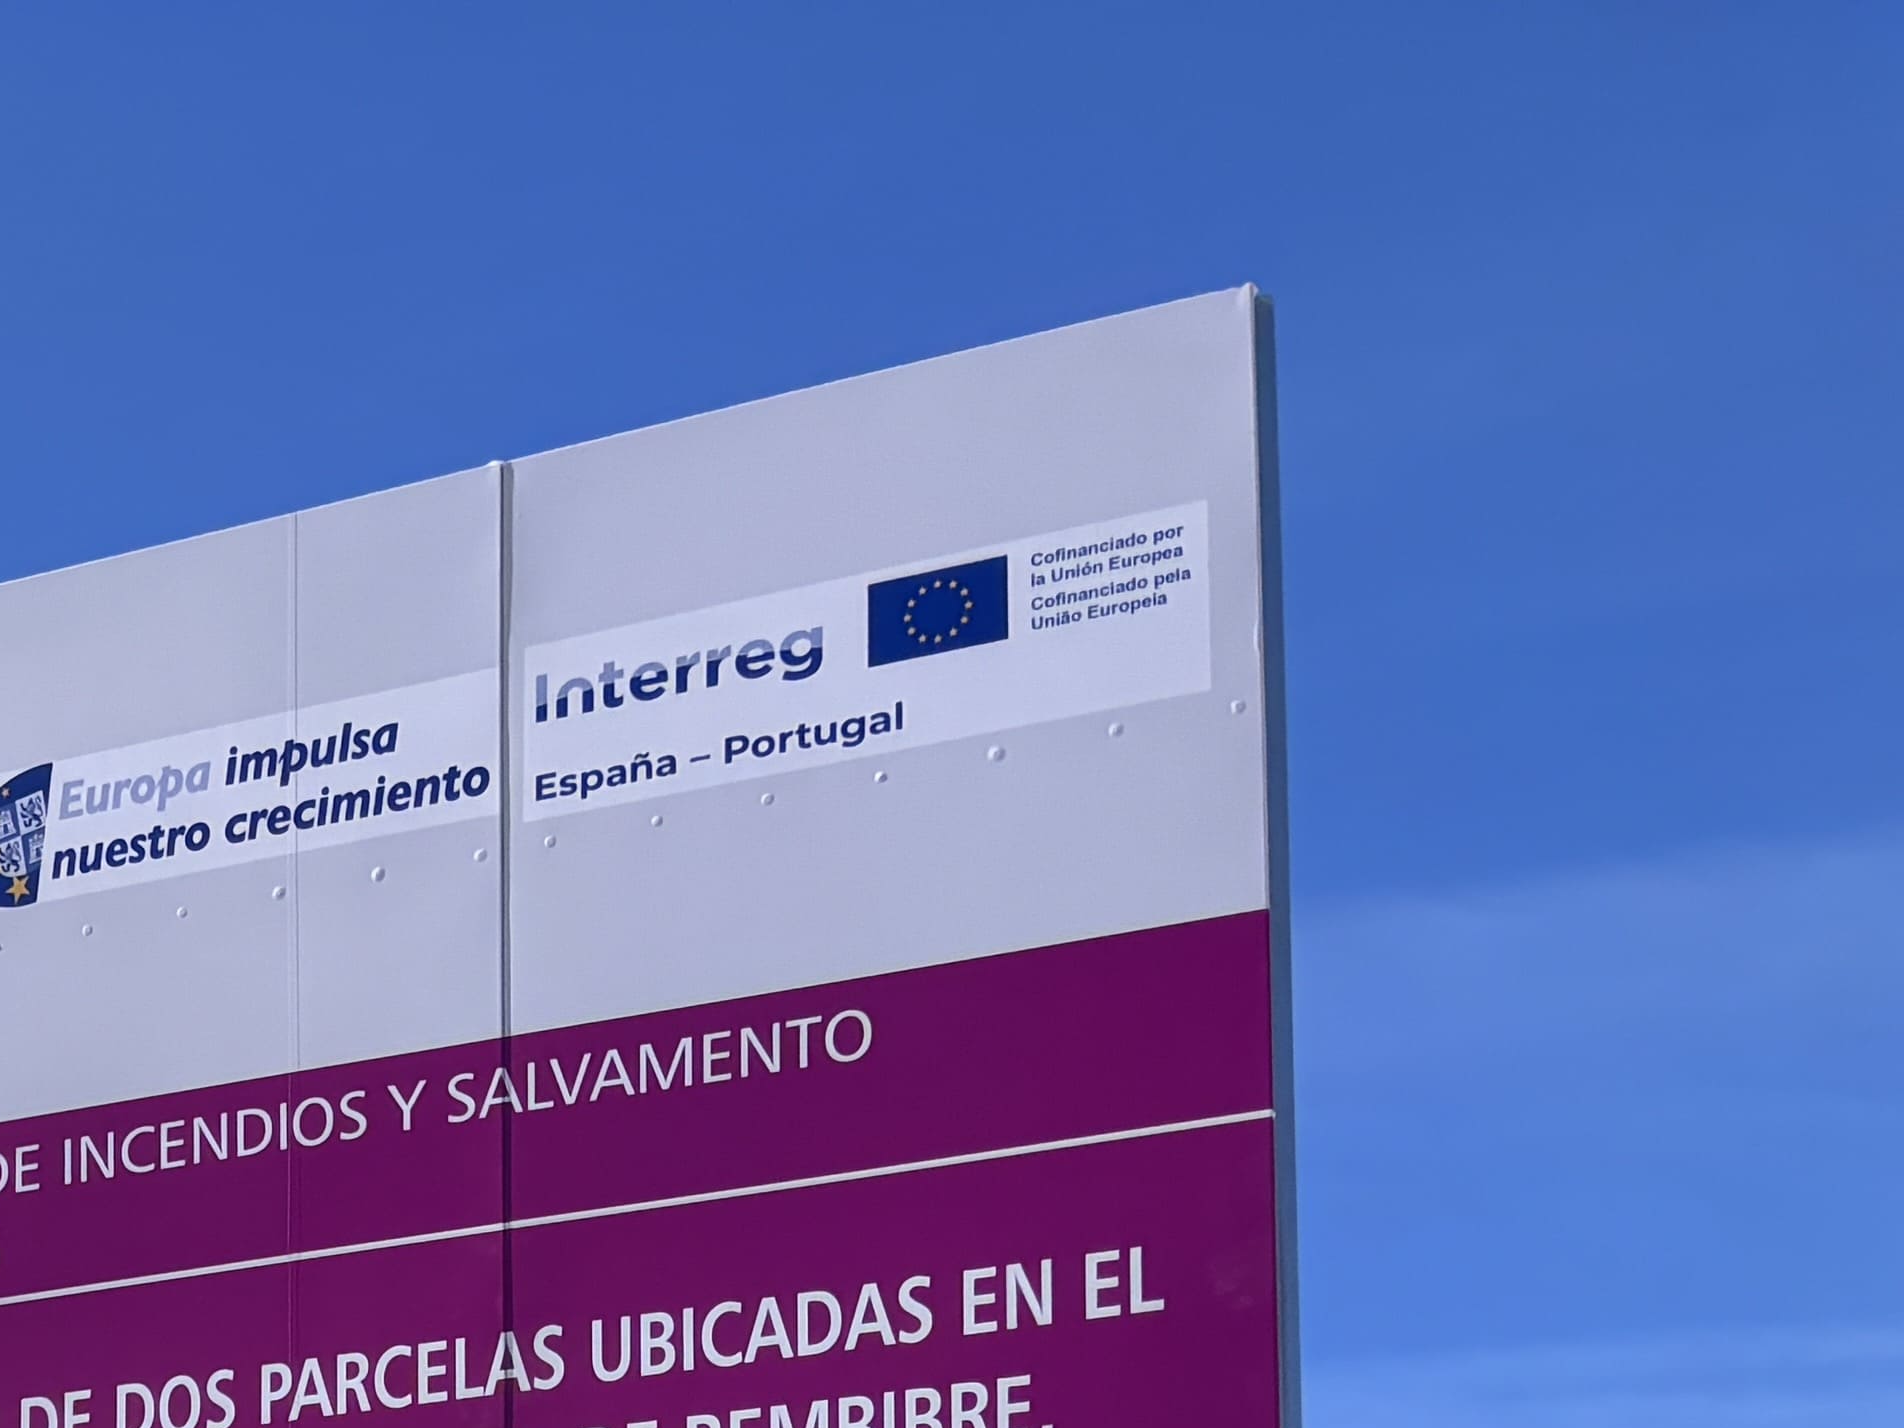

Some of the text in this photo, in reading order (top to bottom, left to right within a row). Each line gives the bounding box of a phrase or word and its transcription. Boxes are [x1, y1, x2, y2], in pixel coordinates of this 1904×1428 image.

[1030, 524, 1185, 568] Cofinanciado por
[1030, 545, 1185, 588] la Unión Europea
[1030, 567, 1192, 611] Cofinanciado pela
[1030, 592, 1168, 632] União Europeia
[534, 625, 824, 723] Interreg
[57, 720, 400, 820] Europa impulsa
[534, 750, 677, 801] España
[723, 699, 903, 765] Portugal
[50, 764, 490, 880] nuestro crecimiento
[63, 1089, 367, 1185] INCENDIOS
[386, 1078, 426, 1131] Y
[447, 1008, 872, 1123] SALVAMENTO
[260, 1323, 565, 1425] PARCELAS
[591, 1274, 933, 1382] UBICADAS
[962, 1258, 1053, 1335] EN
[1084, 1245, 1164, 1320] EL
